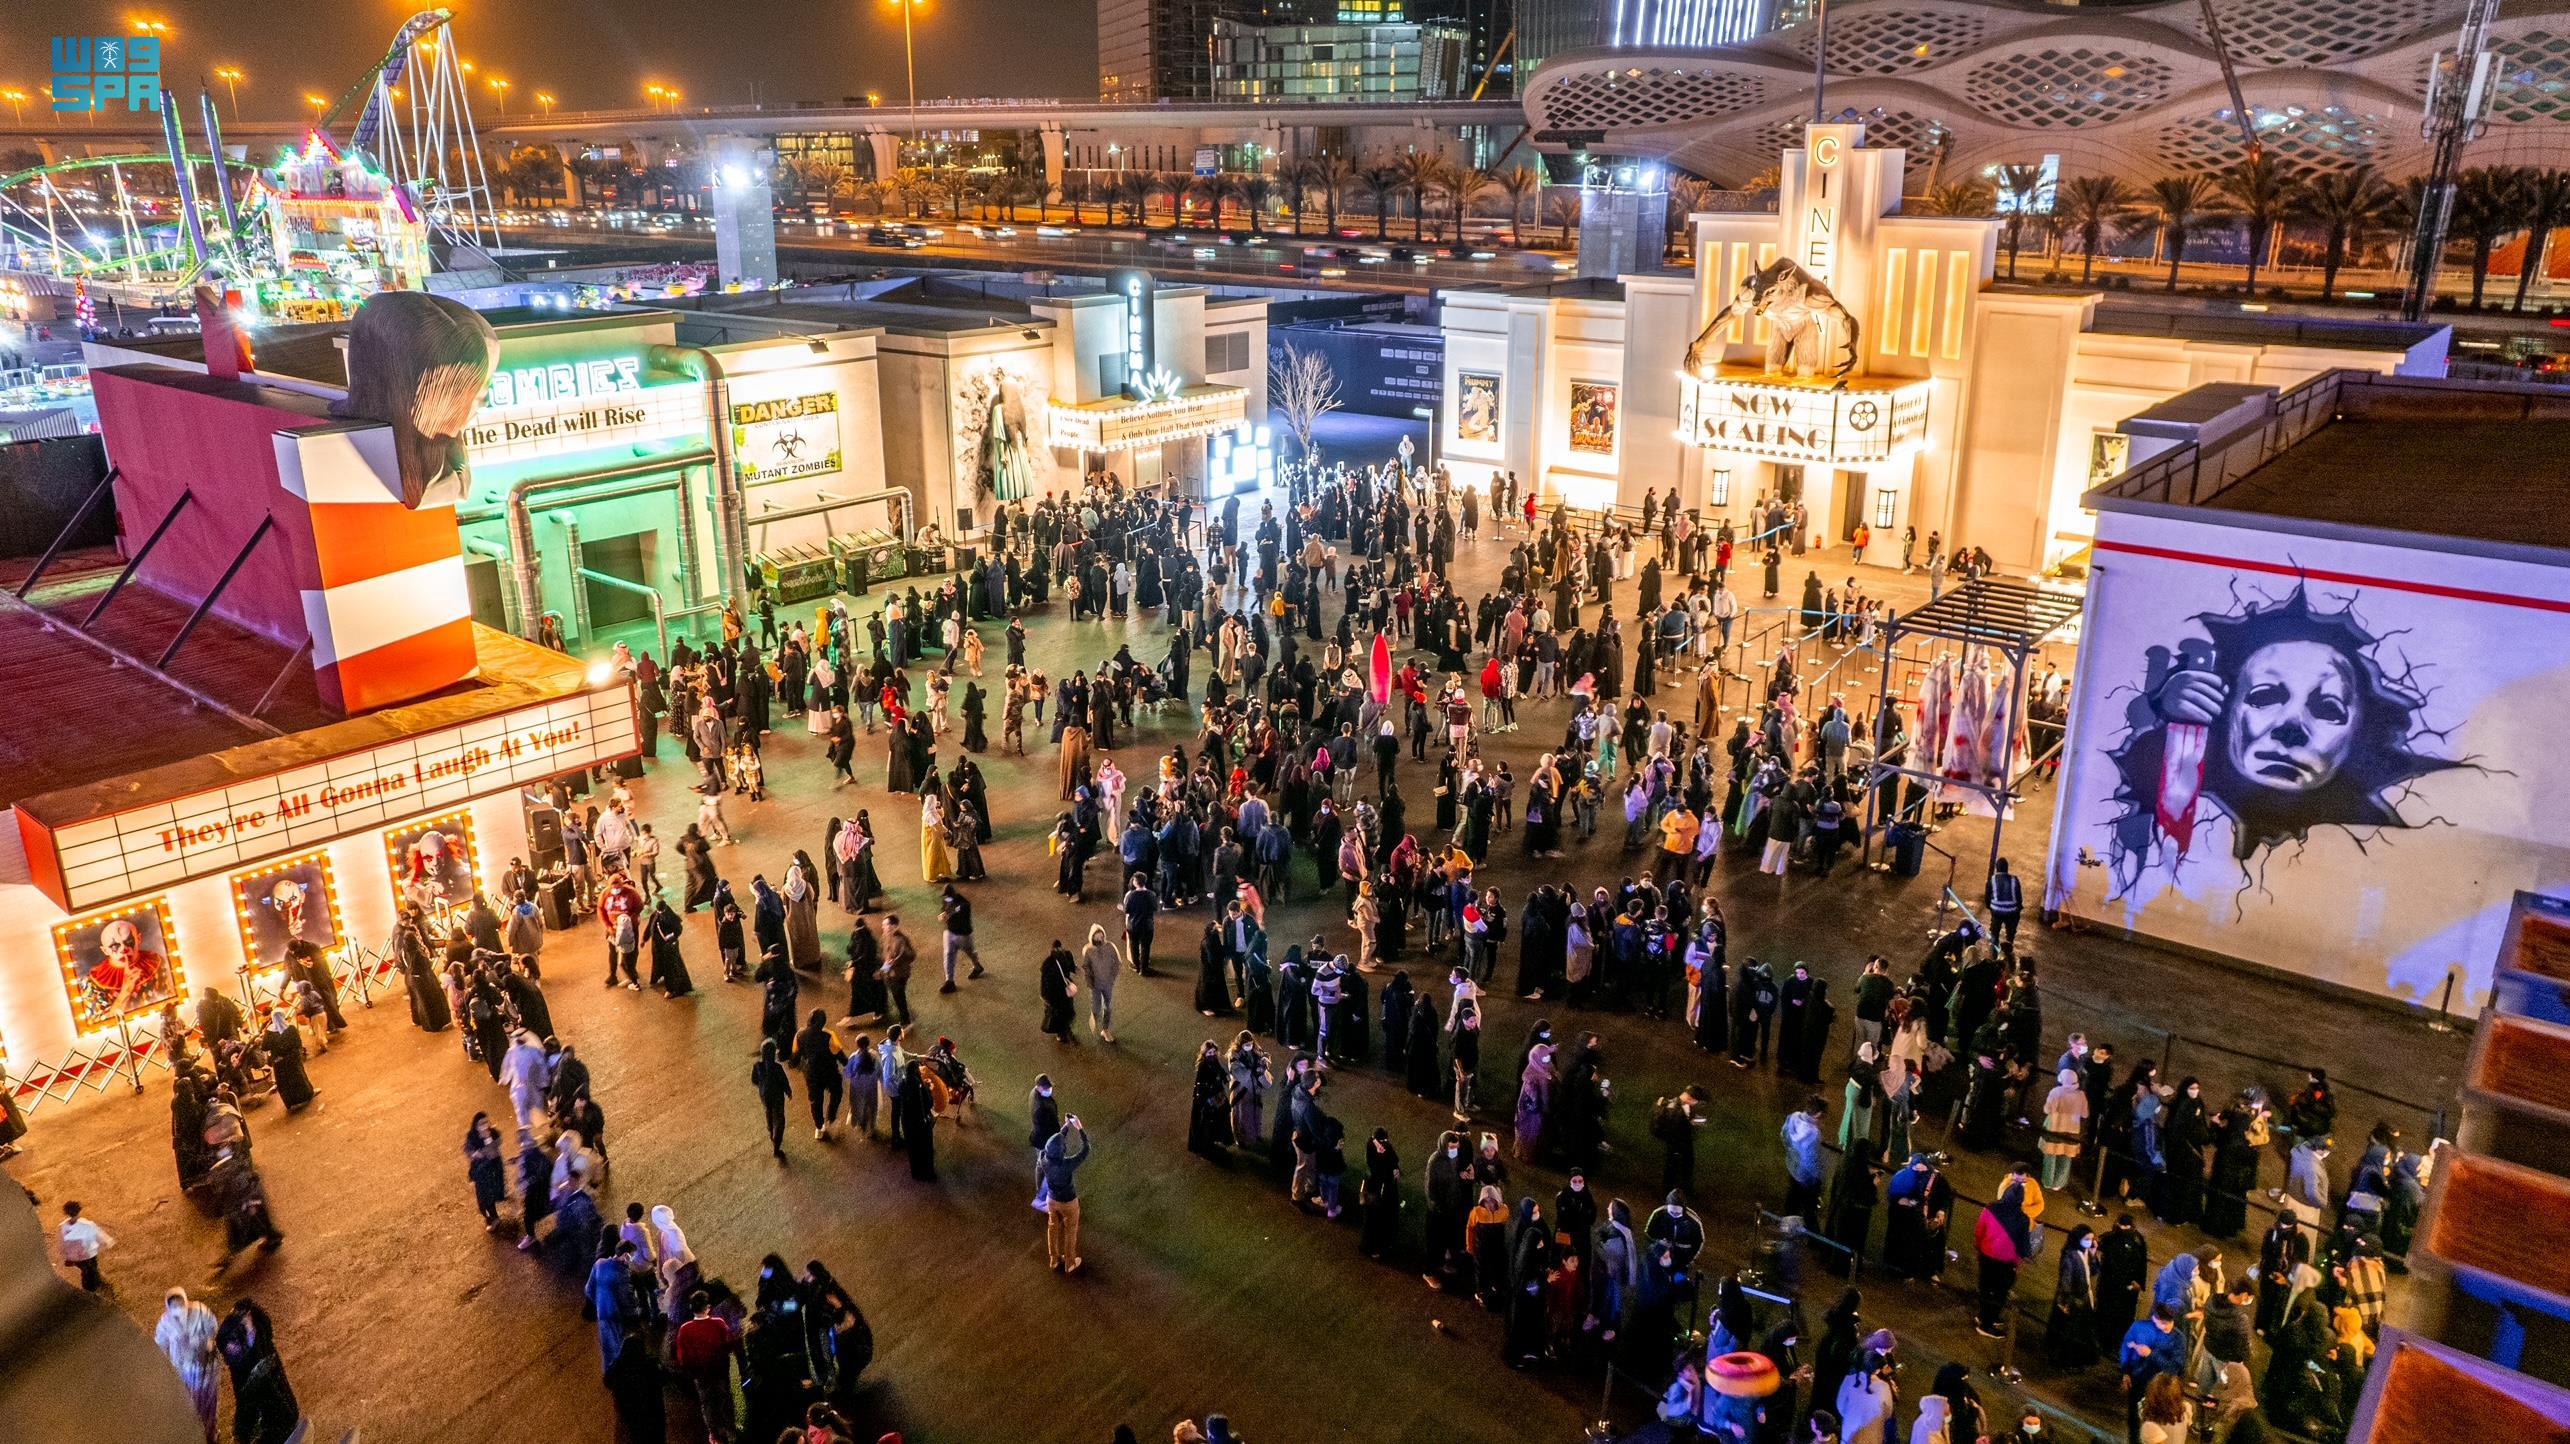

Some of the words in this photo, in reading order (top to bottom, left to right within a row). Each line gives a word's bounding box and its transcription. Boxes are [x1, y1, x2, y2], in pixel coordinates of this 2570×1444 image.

[1809, 138, 1838, 333] CINE
[1128, 278, 1144, 387] CINEMA
[487, 356, 642, 406] OMBIES
[740, 395, 831, 423] DANGER
[1120, 414, 1145, 425] Believe
[1146, 409, 1172, 419] Nothing
[1174, 407, 1186, 415] You
[1187, 404, 1204, 412] Hear
[1731, 391, 1798, 417] NOW
[505, 417, 557, 441] Dead
[564, 411, 598, 432] will
[604, 407, 647, 427] Rise
[1121, 433, 1127, 441] &
[1128, 429, 1143, 440] Only
[1145, 428, 1158, 437] One
[1160, 425, 1174, 434] Half
[1175, 422, 1189, 431] That
[1190, 420, 1203, 429] You
[1703, 418, 1827, 450] SCARING
[744, 467, 788, 482] MUTANT
[791, 459, 836, 474] ZOMBIES
[155, 806, 266, 853] They're
[275, 793, 311, 822] All
[320, 773, 407, 809] Gonna
[414, 747, 491, 784] Laugh
[498, 738, 522, 760] At
[527, 721, 581, 753] You!
